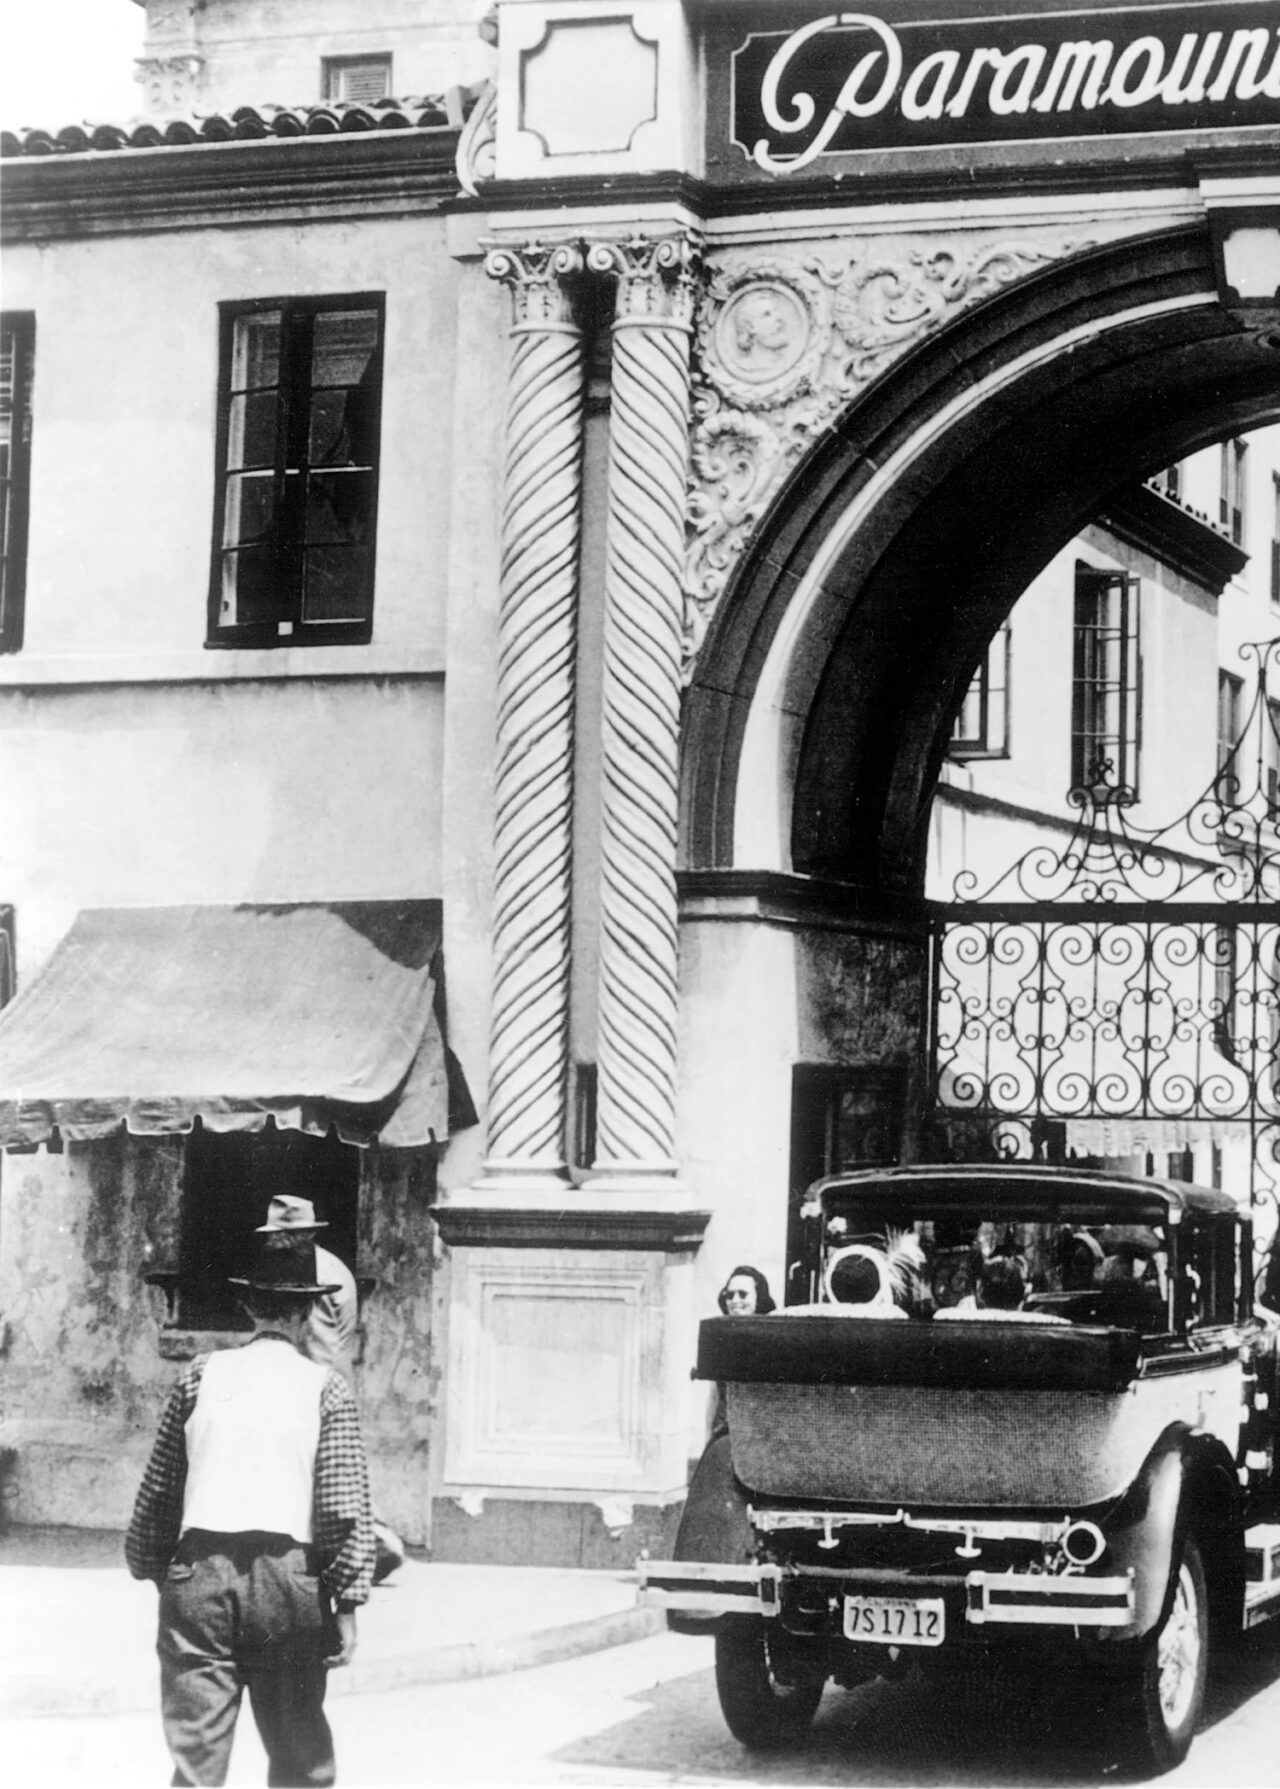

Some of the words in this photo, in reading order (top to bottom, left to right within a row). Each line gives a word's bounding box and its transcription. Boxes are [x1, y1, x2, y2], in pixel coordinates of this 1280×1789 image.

[850, 1606, 875, 1633] 7S
[882, 1609, 906, 1635] 17
[913, 1610, 938, 1638] 12
